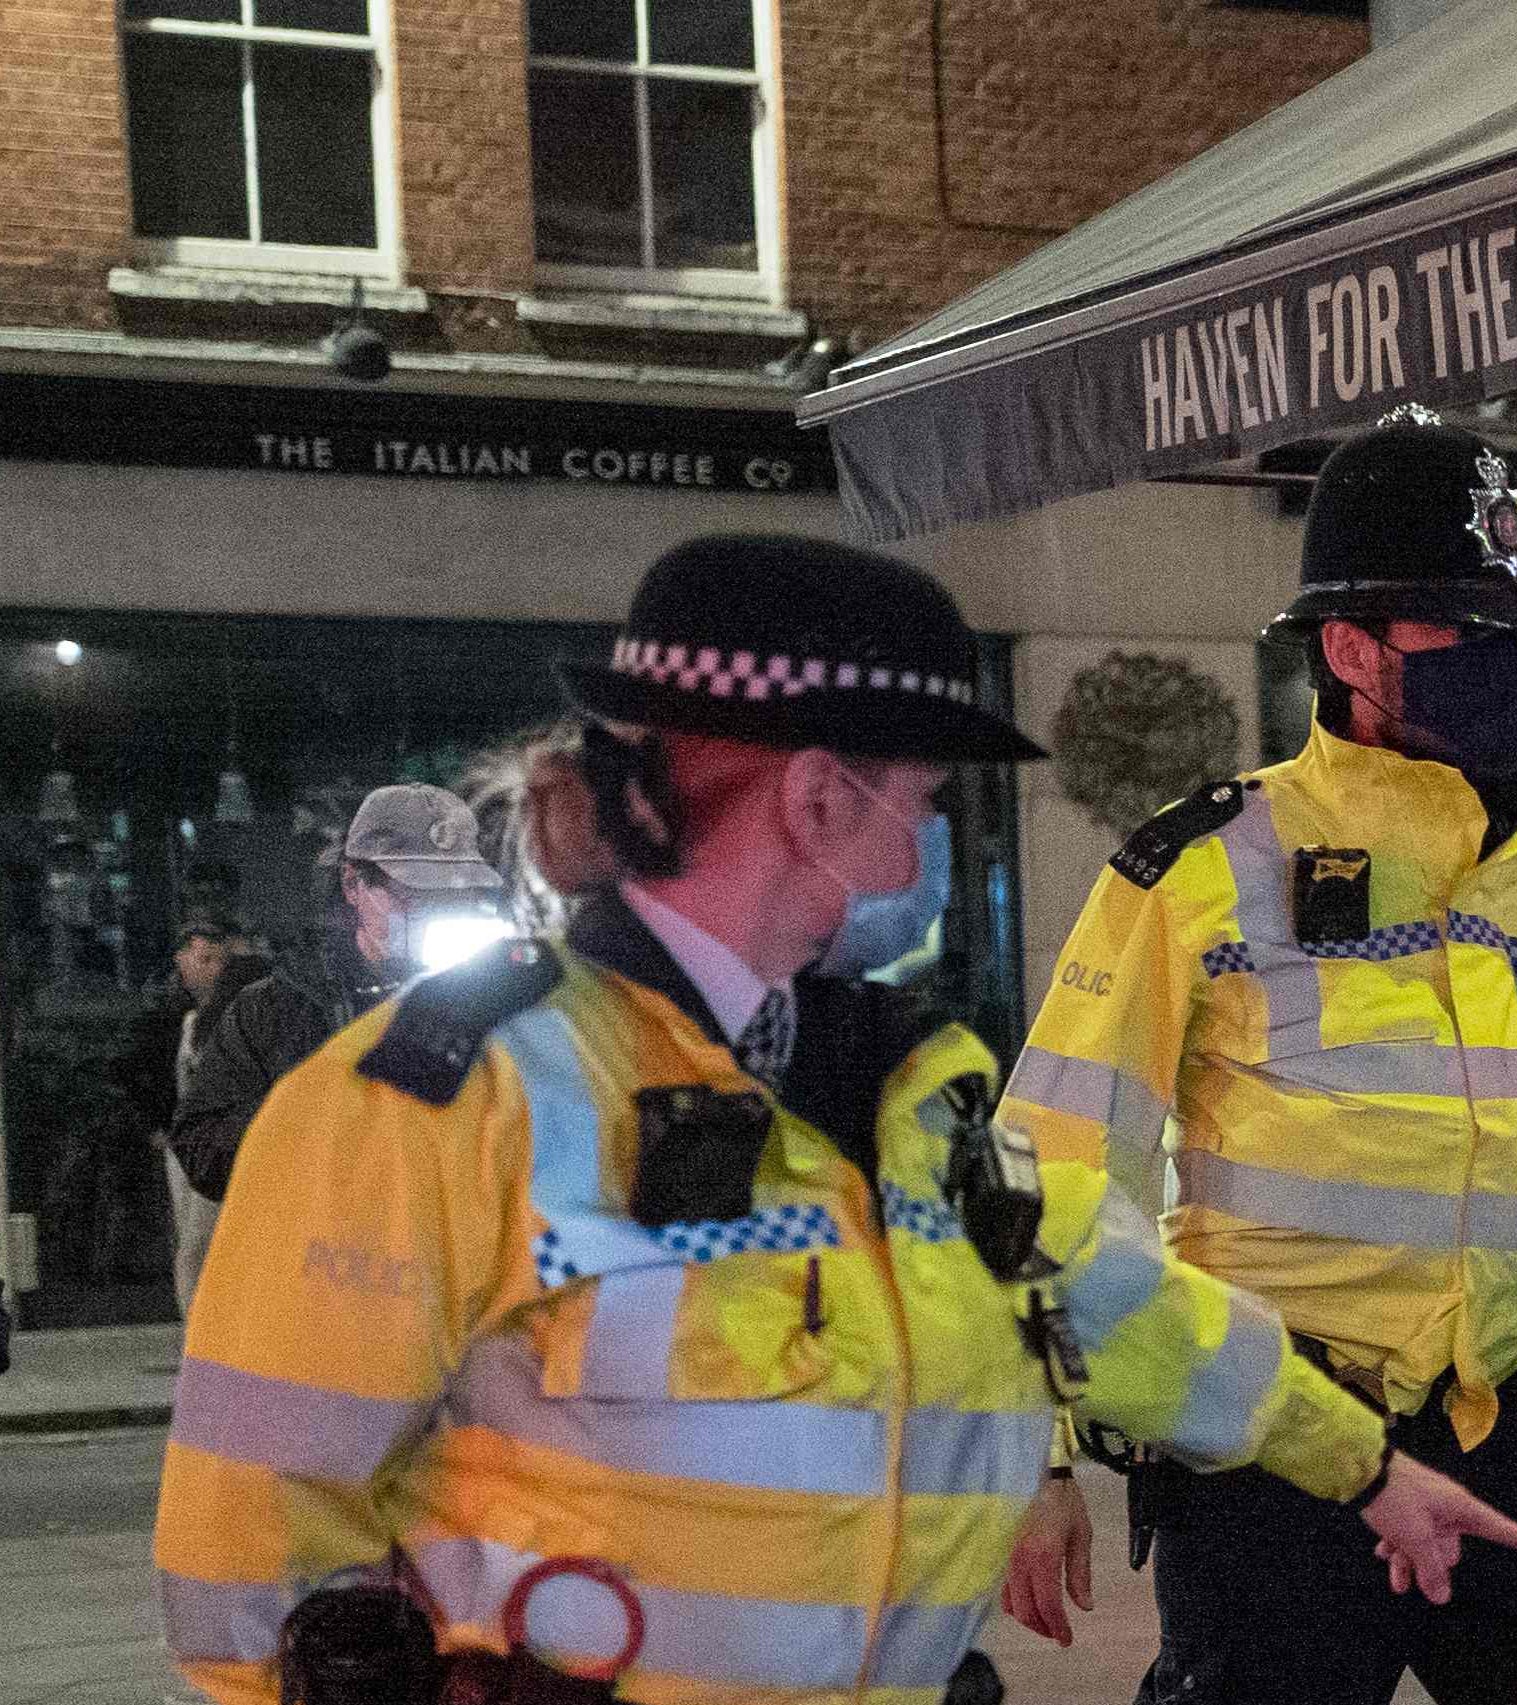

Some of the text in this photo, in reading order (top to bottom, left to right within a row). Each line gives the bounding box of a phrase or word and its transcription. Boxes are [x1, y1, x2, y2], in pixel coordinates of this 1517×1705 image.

[1140, 299, 1289, 452] HAVEN
[1306, 264, 1405, 409] FOR
[255, 433, 334, 469] THE
[374, 440, 532, 475] ITALIAN
[561, 447, 715, 485] COFFEE
